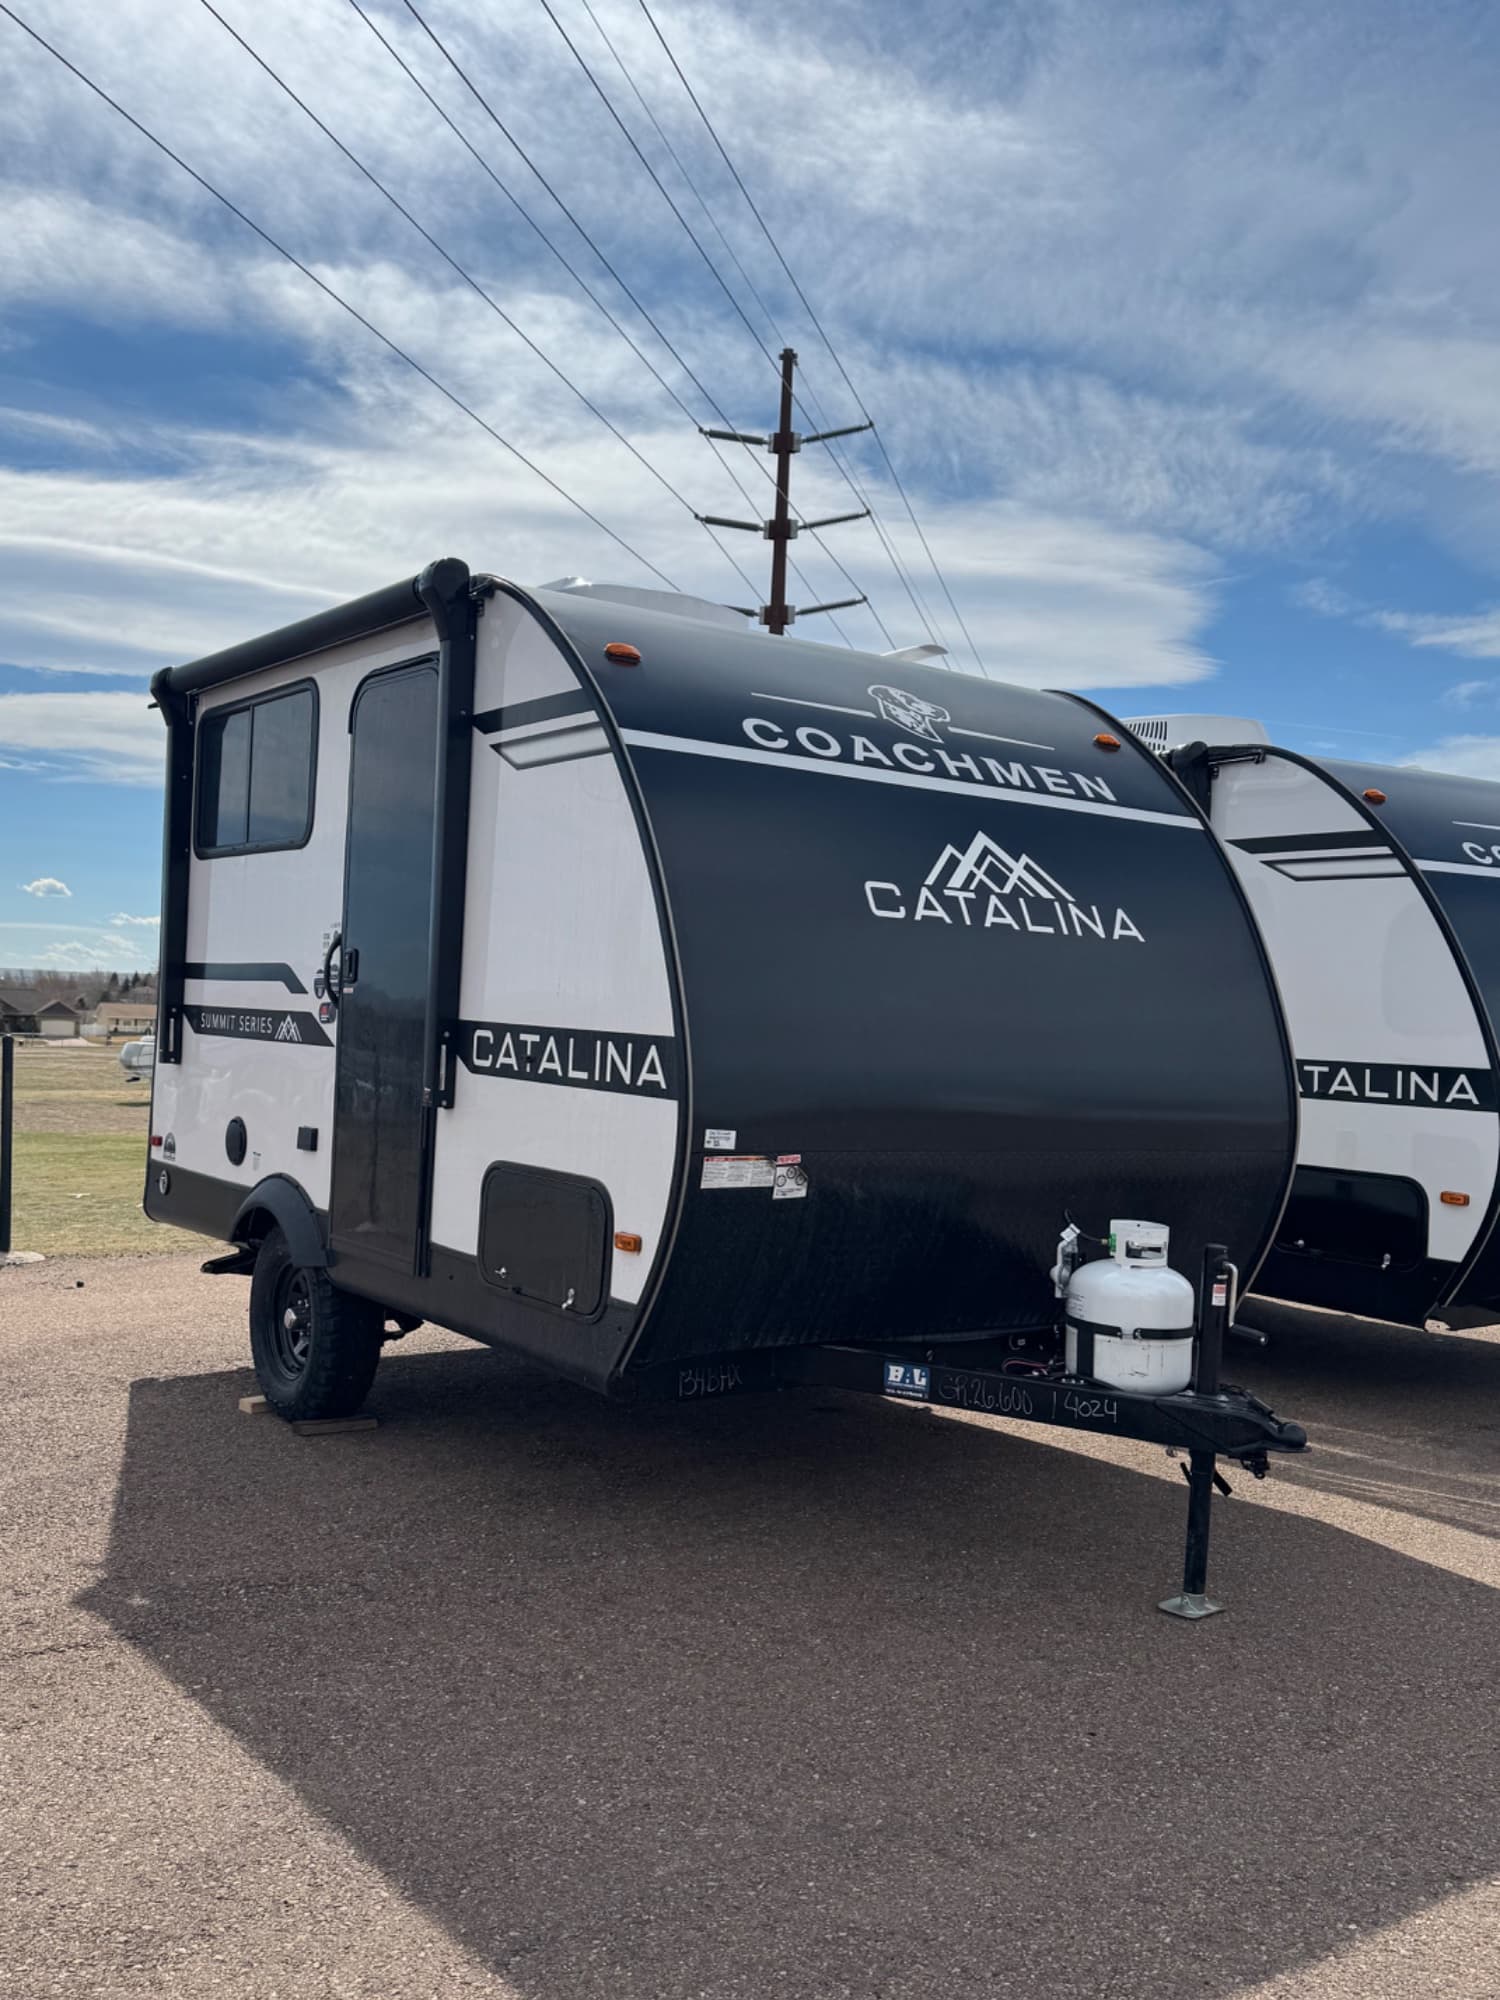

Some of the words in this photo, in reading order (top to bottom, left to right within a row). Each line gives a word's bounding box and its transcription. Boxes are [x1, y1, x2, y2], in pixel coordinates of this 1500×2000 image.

[742, 718, 1117, 801] COACHMEN
[864, 881, 1145, 942] CATALINA
[201, 1012, 236, 1031] SUMMIT
[239, 1015, 273, 1034] SERIES
[473, 1029, 667, 1089] CATALINA
[1298, 1065, 1480, 1105] TALINA
